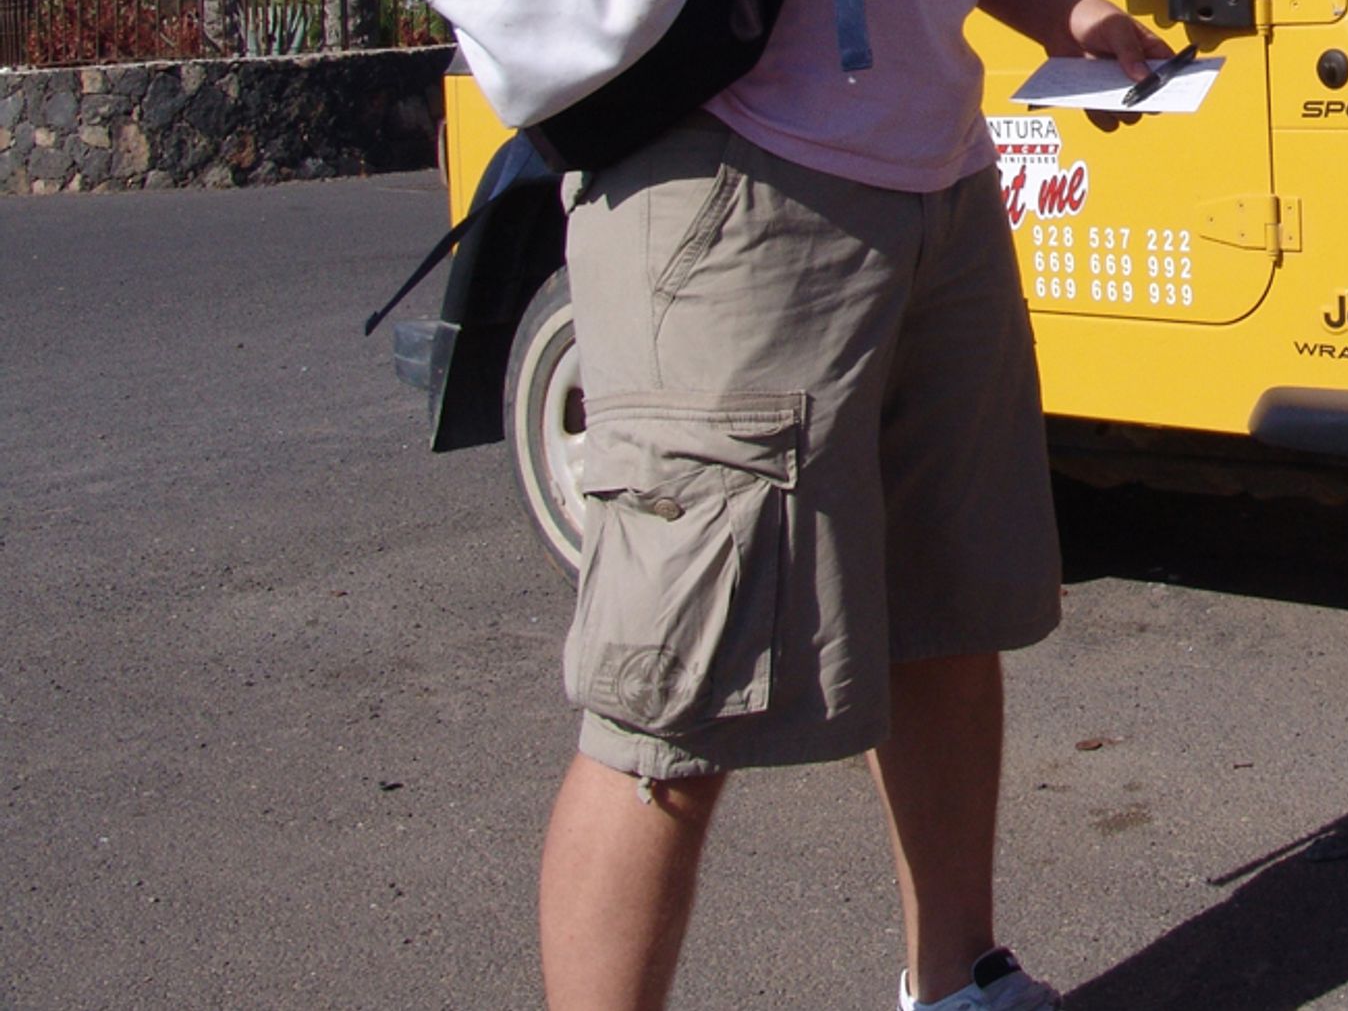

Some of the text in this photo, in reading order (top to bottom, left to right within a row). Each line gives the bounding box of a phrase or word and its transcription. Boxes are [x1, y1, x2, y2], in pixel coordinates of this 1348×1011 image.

[988, 119, 1058, 139] NTURA
[1038, 166, 1086, 215] me
[1032, 225, 1191, 251] 928 537 222
[1034, 250, 1192, 279] 669 669 992
[1035, 276, 1193, 306] 669 669 939
